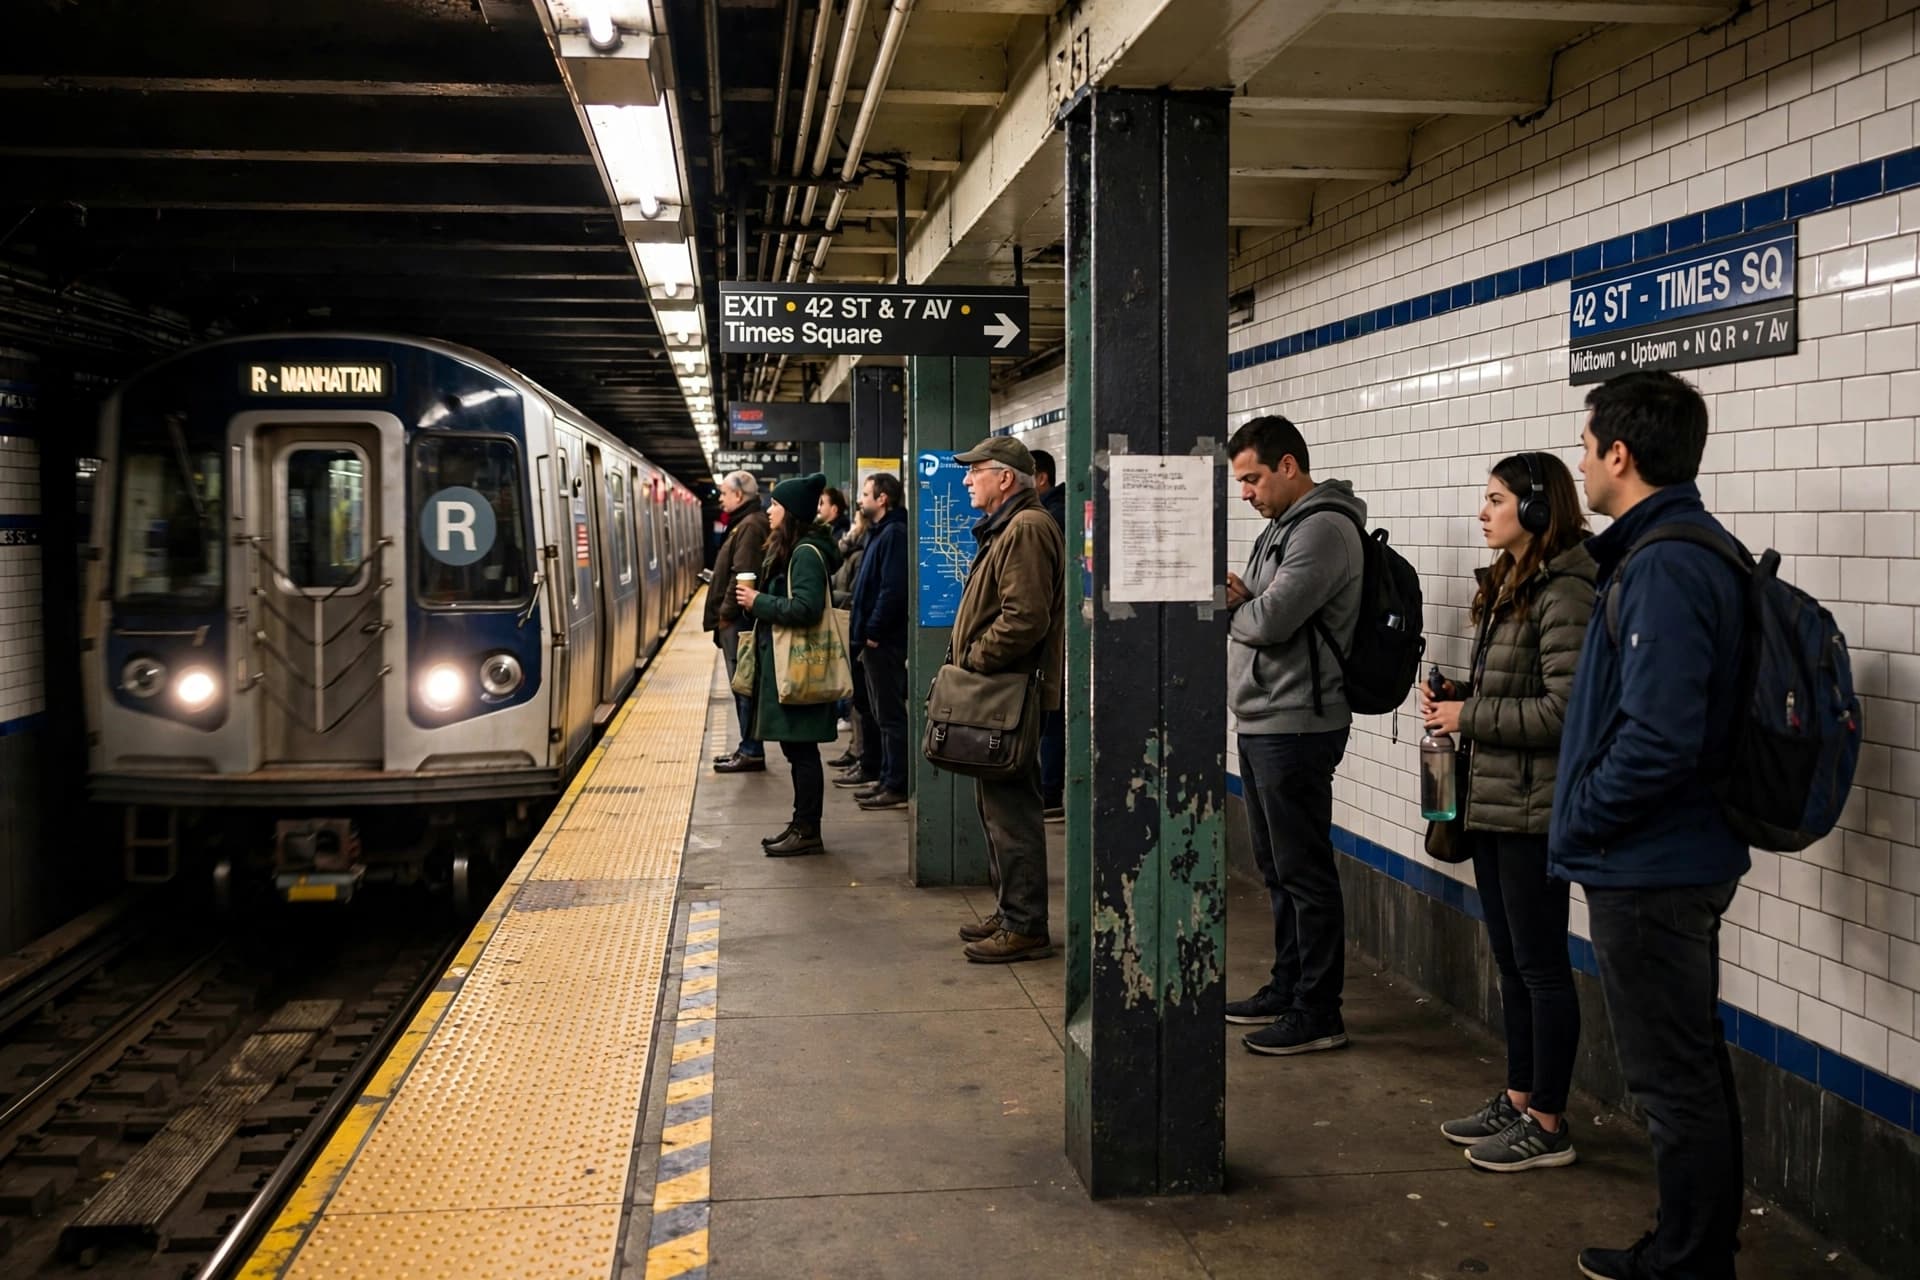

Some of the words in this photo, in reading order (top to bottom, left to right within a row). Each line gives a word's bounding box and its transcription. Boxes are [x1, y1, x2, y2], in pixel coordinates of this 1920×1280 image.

[1573, 291, 1597, 328] 42
[1604, 283, 1632, 324] ST
[1657, 258, 1731, 311] TIMES
[1741, 246, 1783, 294] SQ
[724, 295, 778, 317] EXIT
[804, 297, 834, 318] 42
[841, 297, 872, 319] ST
[878, 298, 896, 319] &
[902, 299, 917, 320] 7
[921, 299, 953, 320] AV
[724, 321, 795, 343] Times
[802, 321, 883, 349] Square
[1570, 349, 1616, 375] Midtown
[1631, 340, 1677, 369] Uptown
[1755, 320, 1765, 345] 7
[1768, 317, 1789, 343] Av
[251, 366, 268, 393] R
[280, 366, 382, 393] MANHATTAN
[436, 500, 478, 551] R
